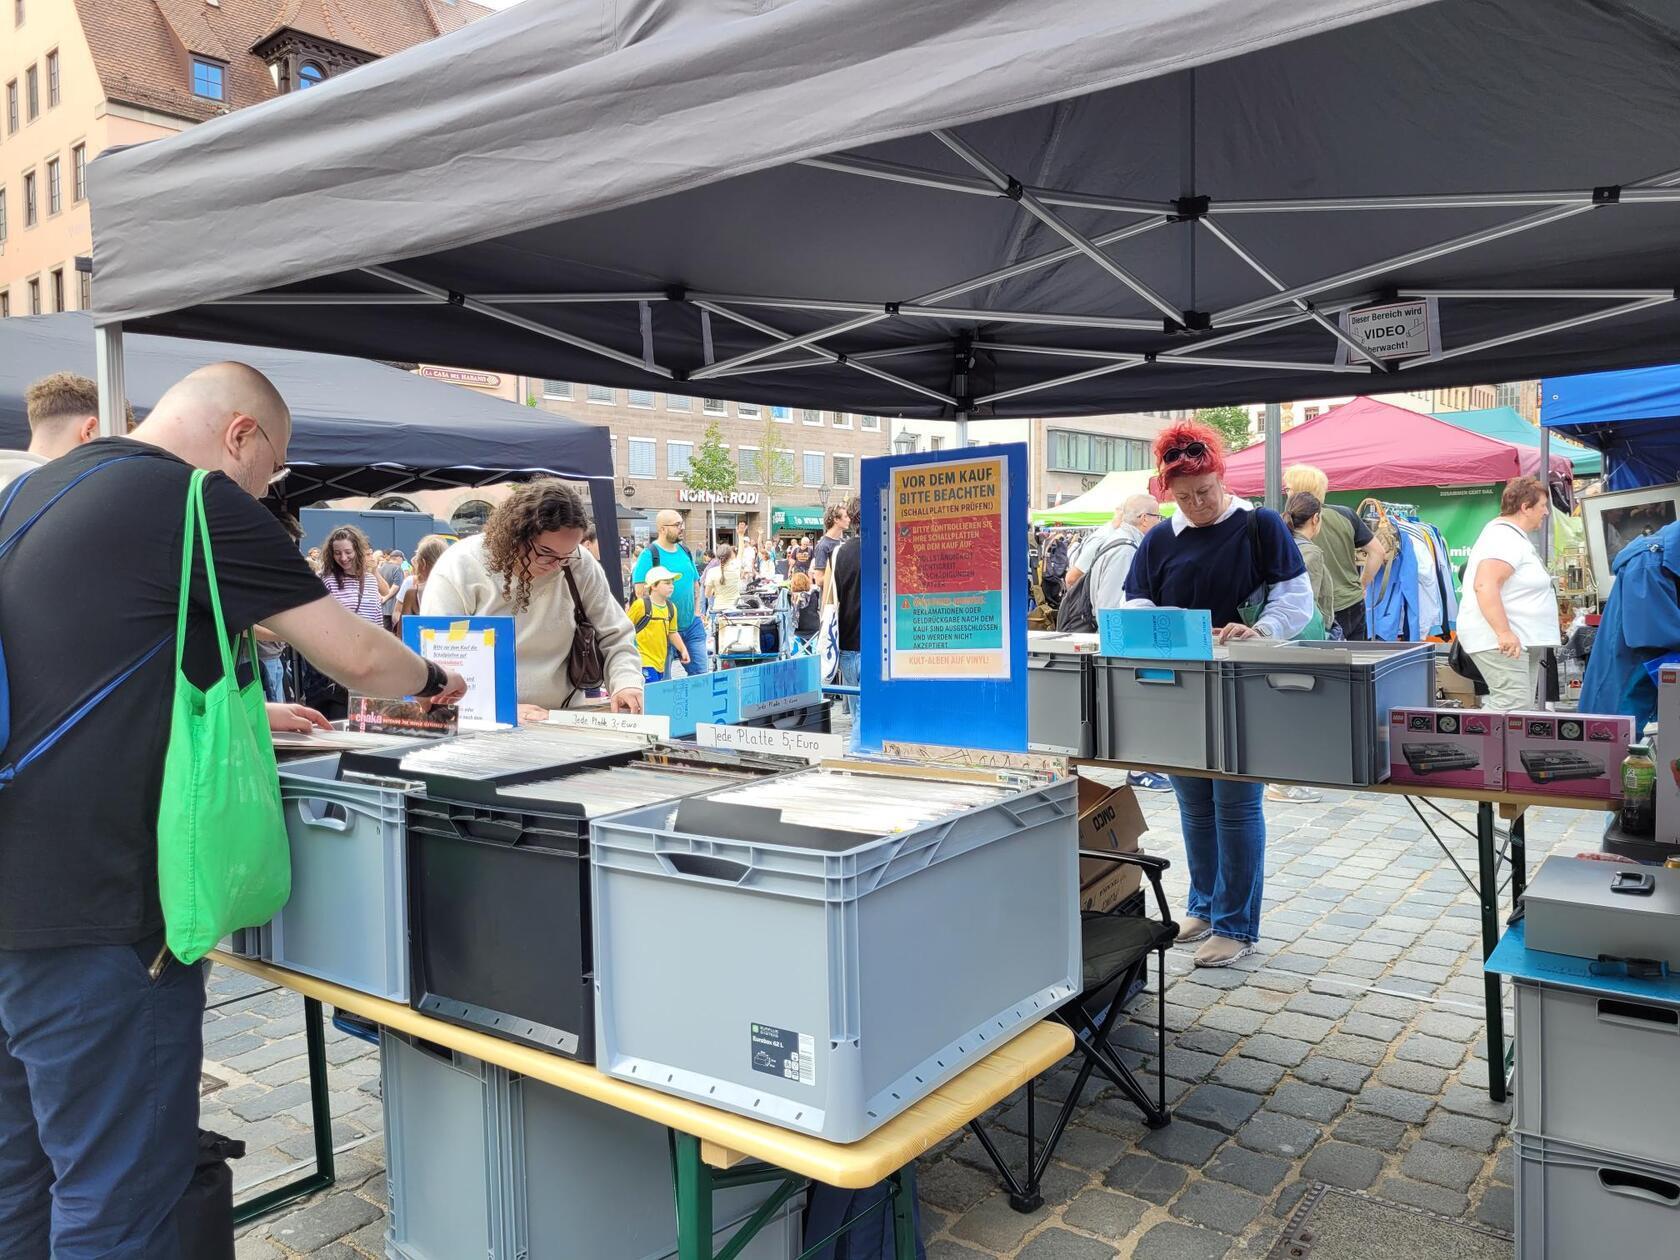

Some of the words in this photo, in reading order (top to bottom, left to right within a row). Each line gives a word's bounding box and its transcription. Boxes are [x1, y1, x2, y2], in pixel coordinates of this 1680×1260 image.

[1352, 314, 1370, 324] Dieser
[1372, 310, 1402, 321] Bereich
[1404, 307, 1422, 316] wird
[1364, 324, 1406, 340] VIDEO
[1366, 340, 1408, 353] berwacht!
[902, 475, 925, 488] VOR
[930, 472, 955, 486] DEM
[960, 468, 992, 482] KAUF
[680, 490, 724, 503] NORMA
[900, 490, 930, 505] BITTE
[934, 484, 995, 502] BEACHTEN
[901, 506, 959, 517] (SCHALLPLATTEN
[961, 502, 993, 512] PRÜFEN!)
[912, 524, 930, 534] BITTE
[982, 520, 993, 528] SIE
[928, 530, 979, 542] SCHALLPLATTEN
[927, 542, 940, 550] DEM
[941, 541, 959, 550] KAUF
[913, 608, 964, 616] REKLAMATIONEN
[909, 656, 948, 665] KULT-ALBEN
[951, 656, 965, 664] AUF
[710, 727, 732, 748] Jede
[737, 729, 774, 746] Platte
